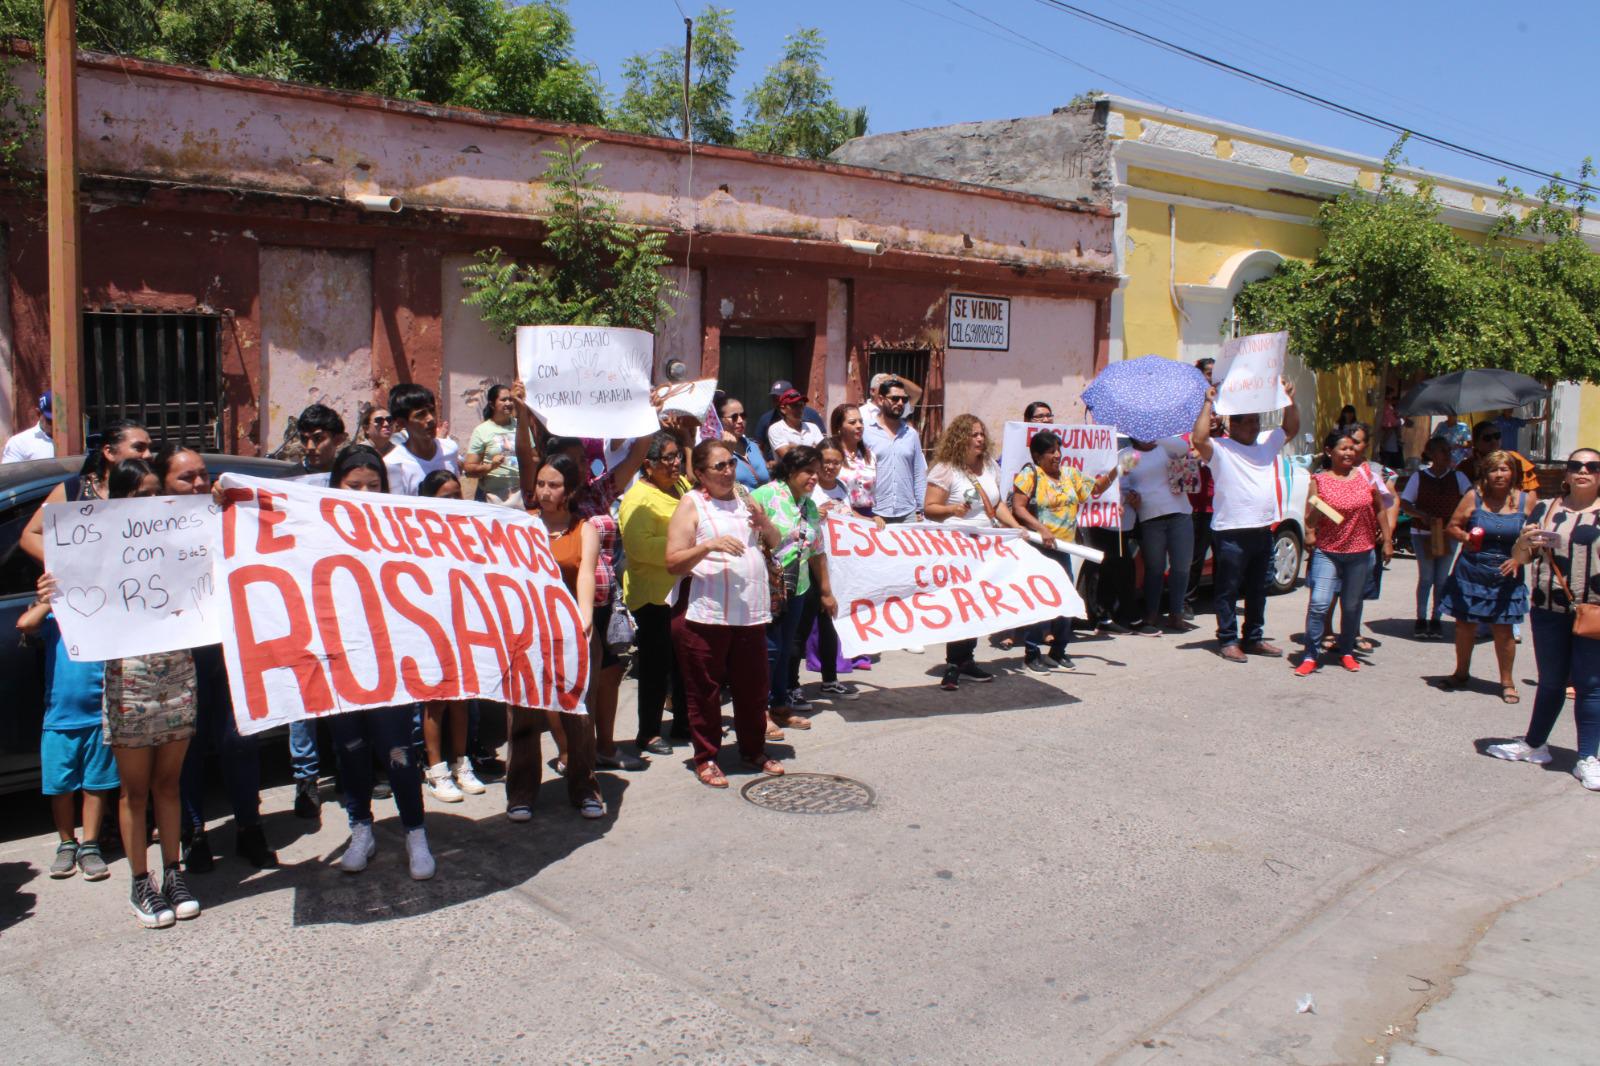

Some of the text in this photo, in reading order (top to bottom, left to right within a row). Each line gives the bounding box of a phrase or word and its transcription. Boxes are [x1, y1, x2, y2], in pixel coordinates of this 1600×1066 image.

[954, 299, 1003, 320] SE VENDE
[548, 331, 610, 351] ROSARIO
[538, 364, 558, 379] CON
[535, 388, 633, 409] ROSARIO SARABIA
[1026, 427, 1112, 450] EUINAPA
[1061, 456, 1084, 472] ON
[1078, 502, 1119, 528] ABIA
[222, 487, 561, 579] TE QUEREMOS
[827, 519, 1019, 561] ESCUINAPA
[178, 549, 188, 561] 5
[199, 545, 208, 557] 5
[914, 563, 972, 589] CON
[118, 575, 170, 612] RS
[850, 574, 1062, 641] ROSARIO
[228, 554, 589, 720] ROSARIO
